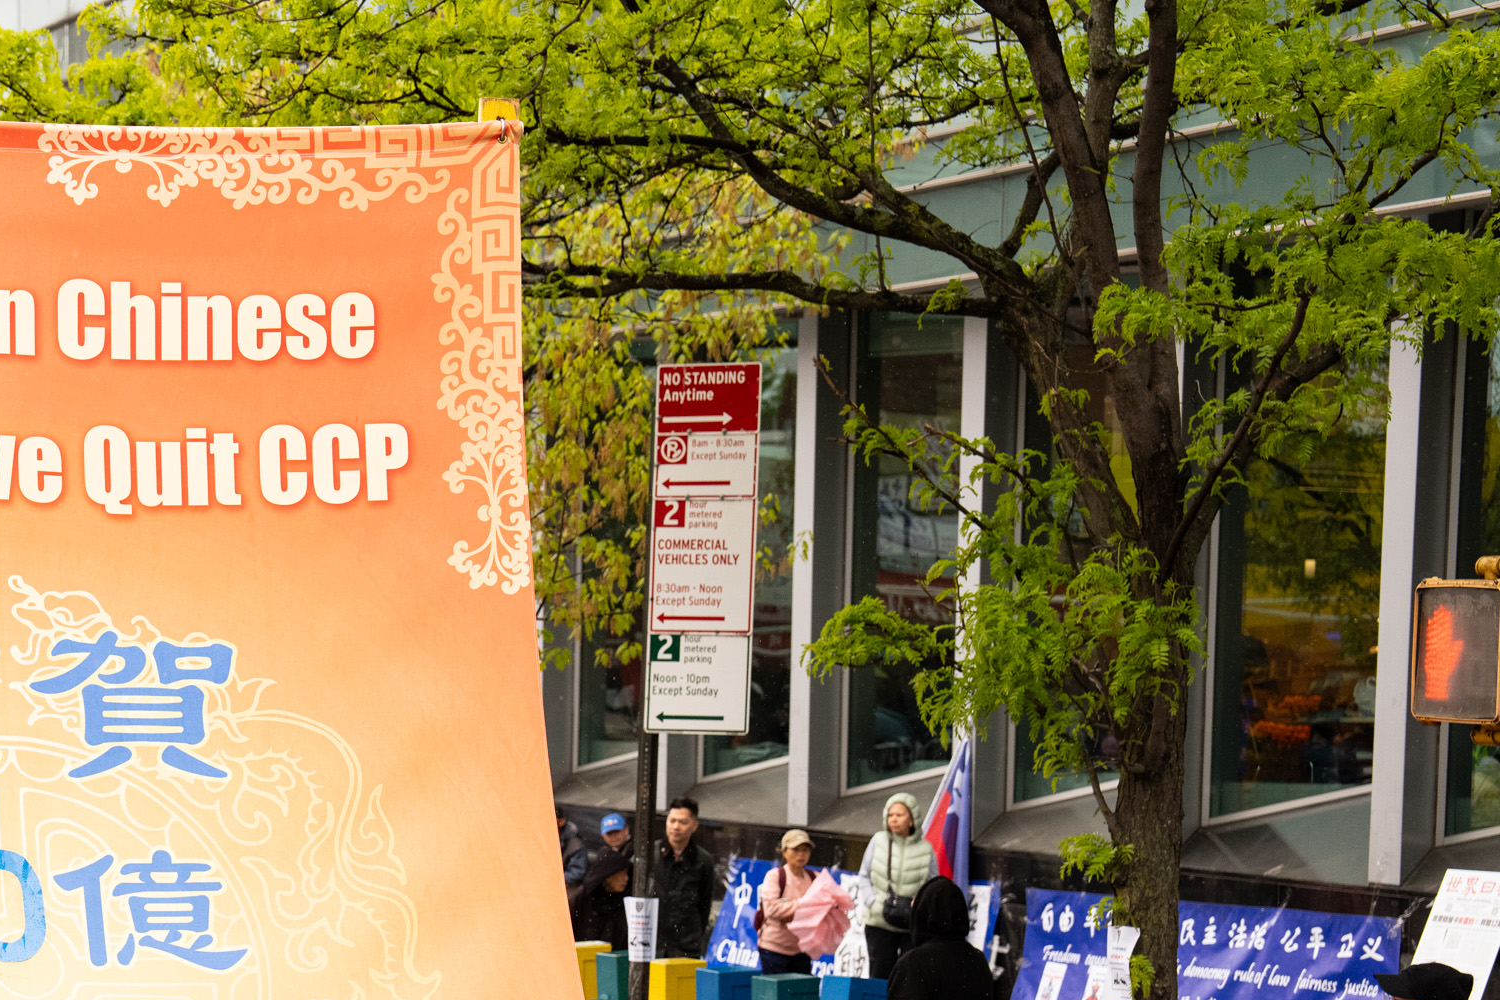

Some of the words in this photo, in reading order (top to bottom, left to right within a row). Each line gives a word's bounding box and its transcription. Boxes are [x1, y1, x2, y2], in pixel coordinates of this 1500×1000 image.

[57, 278, 376, 362] Chinese
[663, 372, 681, 386] NO
[683, 370, 746, 386] STANDING
[663, 388, 715, 404] Anytime
[691, 439, 709, 447] 8am
[715, 438, 745, 447] 8:30am
[691, 451, 717, 461] Except
[719, 451, 747, 461] Sunday
[83, 424, 242, 515] Quit
[259, 422, 410, 505] CCP
[662, 500, 680, 526] 2
[688, 510, 723, 519] metered
[688, 520, 718, 530] parking
[657, 538, 728, 551] COMMERCIAL
[657, 553, 709, 565] VEHICLES
[711, 553, 740, 566] ONLY
[656, 583, 690, 593] 8:30am
[698, 583, 723, 594] Noon
[655, 596, 686, 607] Except
[688, 596, 722, 608] Sunday
[656, 634, 674, 660] 2
[683, 645, 717, 654] metered
[683, 655, 713, 665] parking
[653, 673, 677, 683] Noon
[686, 673, 710, 685] 10pm
[652, 685, 683, 697] Except
[685, 685, 719, 698] Sunday
[1179, 916, 1218, 947] 民主
[1228, 917, 1269, 951] 法治
[1280, 926, 1326, 961] 公平
[1336, 932, 1385, 962] 正义
[716, 938, 760, 969] China
[1042, 943, 1082, 966] Freedom
[1183, 956, 1231, 990] democracy
[1267, 964, 1291, 987] law
[1293, 968, 1337, 994] fairness
